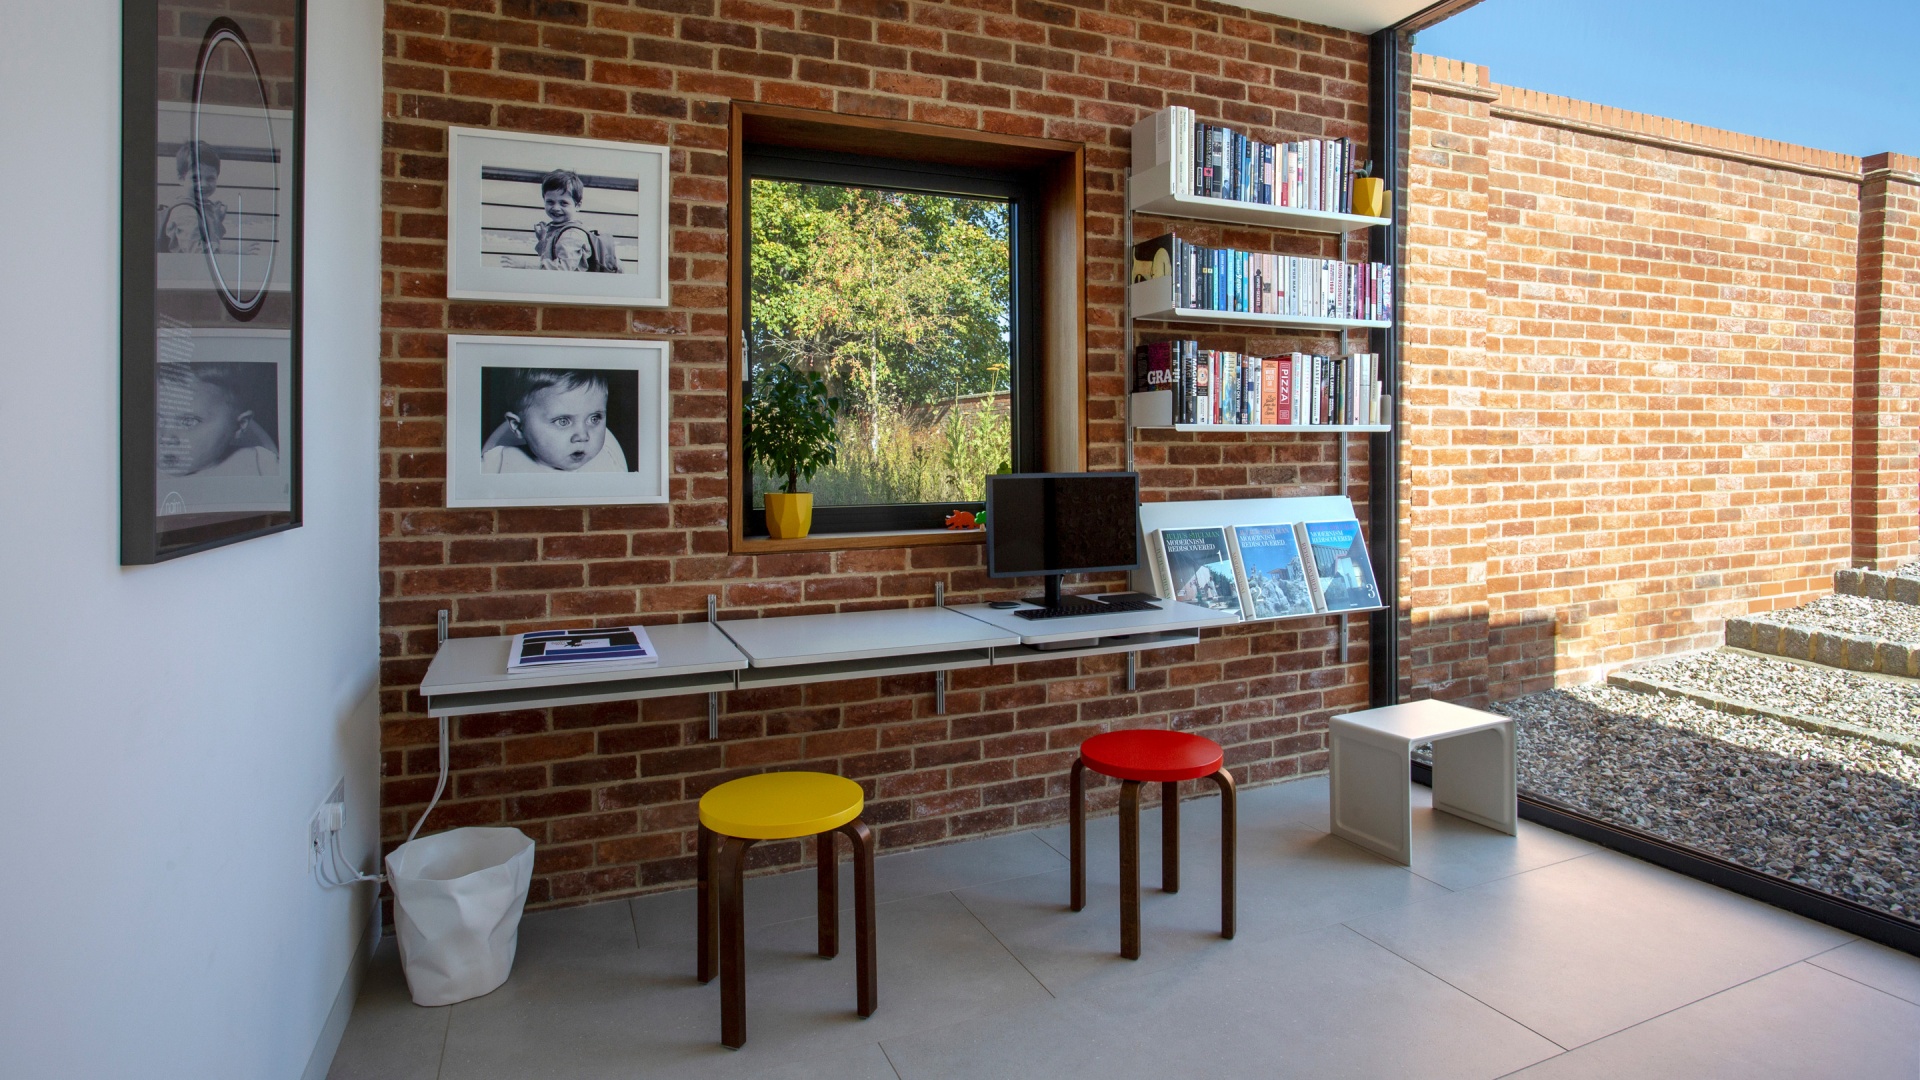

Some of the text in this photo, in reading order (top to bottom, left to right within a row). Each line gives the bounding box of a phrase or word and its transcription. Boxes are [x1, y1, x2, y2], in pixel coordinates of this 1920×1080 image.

[1281, 369, 1289, 402] PIZZA
[1239, 533, 1276, 542] MODERNISM
[1310, 530, 1344, 538] MODERNISM
[1166, 538, 1205, 546] MODERNISM
[1241, 539, 1286, 548] REDISCOVERED
[1311, 535, 1353, 543] REDISCOVERED
[1167, 543, 1216, 553] REDISCOVERED
[1216, 550, 1224, 565] 1
[1253, 586, 1265, 602] 2
[1366, 583, 1376, 599] 3
